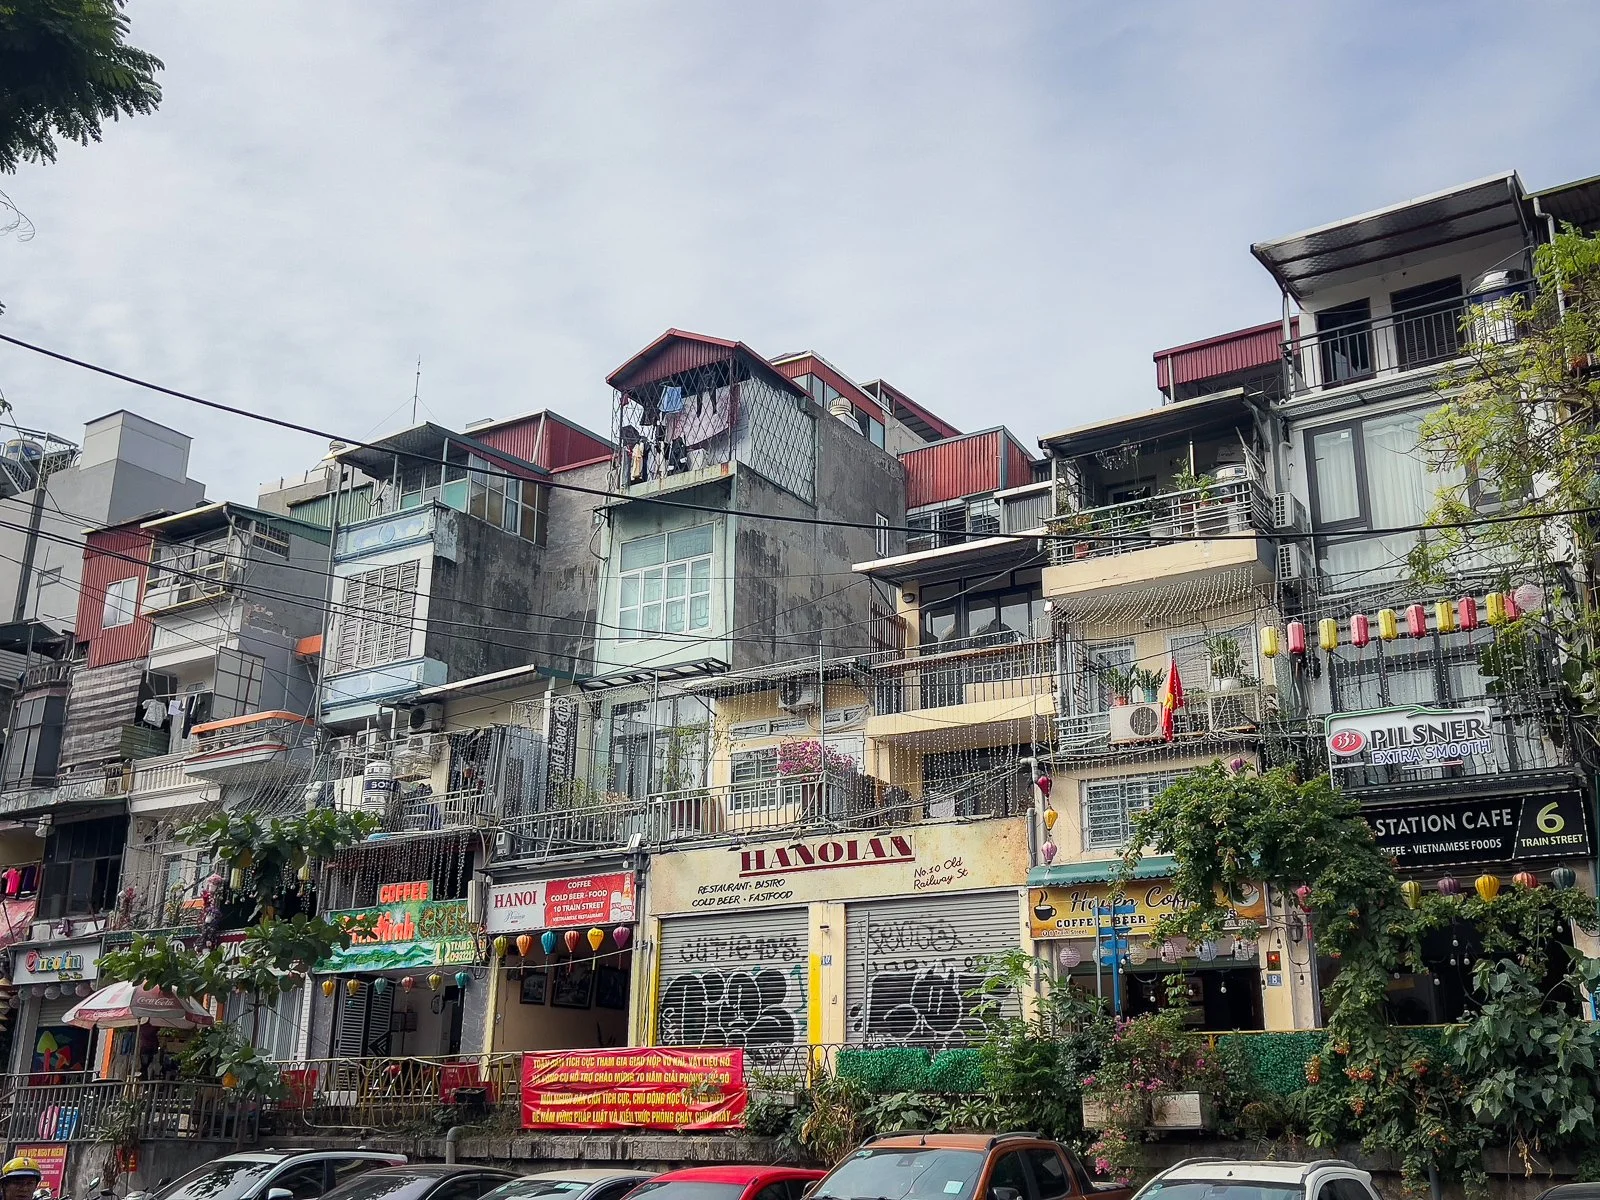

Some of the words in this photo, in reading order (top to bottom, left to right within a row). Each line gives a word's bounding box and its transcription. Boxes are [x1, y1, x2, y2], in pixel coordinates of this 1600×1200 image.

[1337, 731, 1356, 748] 333
[1370, 719, 1489, 750] PILSNER
[1371, 748, 1422, 765] EXTRA
[1425, 738, 1491, 760] SMOOTH
[1376, 813, 1455, 836] STATION
[1462, 808, 1513, 829] CAFE
[1536, 801, 1565, 834] 6
[1413, 841, 1470, 854] VIETNAMESE
[1471, 838, 1502, 850] FOODS
[1521, 836, 1549, 848] TRAIN
[1550, 834, 1583, 845] STREET
[740, 834, 913, 872] HANOIAN
[943, 856, 964, 870] Old
[567, 880, 592, 889] COFFEE
[698, 881, 750, 895] RESTAURANT
[754, 878, 786, 890] BISTRO
[913, 874, 953, 890] Railway
[957, 868, 969, 879] St
[379, 882, 429, 903] COFFEE
[494, 890, 538, 909] HANOI
[550, 894, 568, 902] COLD
[568, 892, 585, 901] BEER
[588, 889, 608, 898] FOOD
[692, 896, 715, 907] COLD
[716, 894, 740, 906] BEER
[748, 890, 794, 903] FASTFOOD
[553, 905, 561, 913] 10
[562, 903, 581, 912] TRAIN
[581, 901, 605, 910] STREET
[1056, 917, 1101, 928] COFFEE
[1114, 915, 1146, 926] BEER
[565, 1056, 581, 1067] TÍCH
[597, 1056, 615, 1067] THAM
[616, 1056, 628, 1067] GIA
[629, 1056, 645, 1066] GIAO
[646, 1054, 662, 1068] NỘP
[688, 1055, 702, 1069] VẬT
[702, 1055, 718, 1069] LIỆU
[594, 1070, 613, 1082] CHÀO
[635, 1072, 645, 1082] 70
[646, 1070, 662, 1082] NĂM
[663, 1069, 678, 1082] GIẢI
[602, 1091, 617, 1105] TÍCH
[666, 1092, 681, 1106] HỌC
[573, 1109, 592, 1123] PHÁP
[592, 1109, 608, 1124] LUẬT
[609, 1108, 618, 1122] VÀ
[634, 1108, 651, 1123] THỨC
[651, 1108, 674, 1123] PHÒNG
